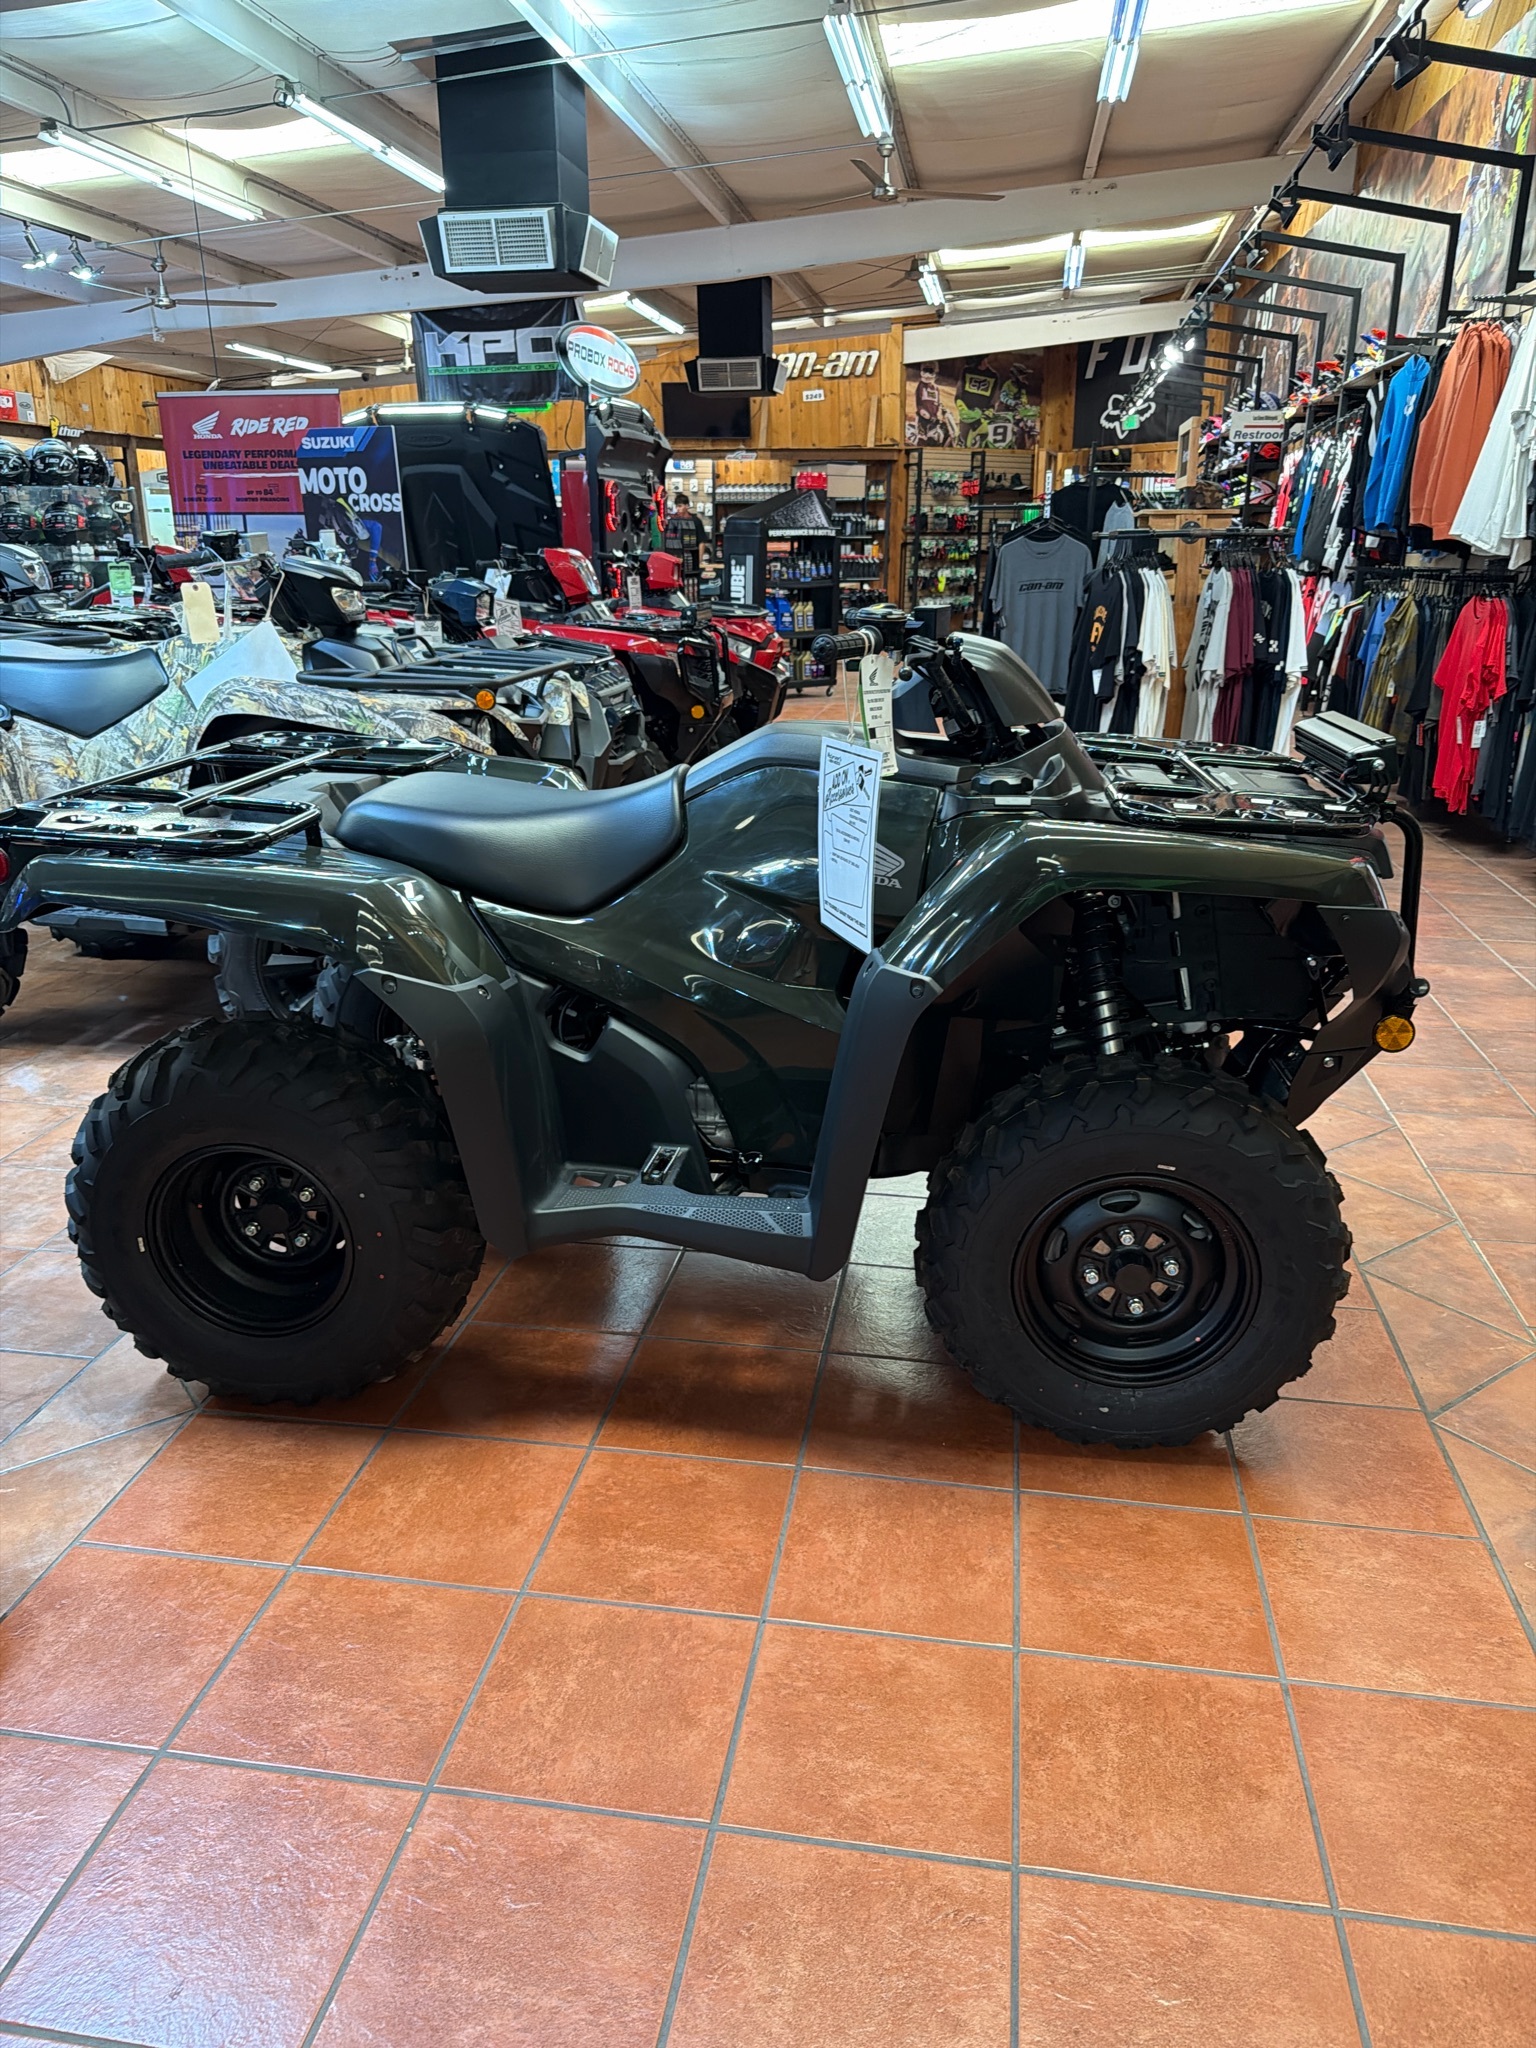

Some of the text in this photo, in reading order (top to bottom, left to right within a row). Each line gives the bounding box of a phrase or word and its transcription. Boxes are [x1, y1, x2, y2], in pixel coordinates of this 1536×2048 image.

[568, 340, 635, 380] PROBOX ROCKS
[772, 350, 880, 378] an-am
[58, 425, 85, 438] thor
[230, 416, 309, 438] RIDE RED
[301, 436, 355, 450] SUZUKI
[182, 450, 242, 460] LEGENDARY
[202, 460, 268, 470] UNBEATABLE
[298, 466, 368, 495] MOTO
[348, 492, 402, 513] CROSS
[1018, 581, 1064, 593] can-am
